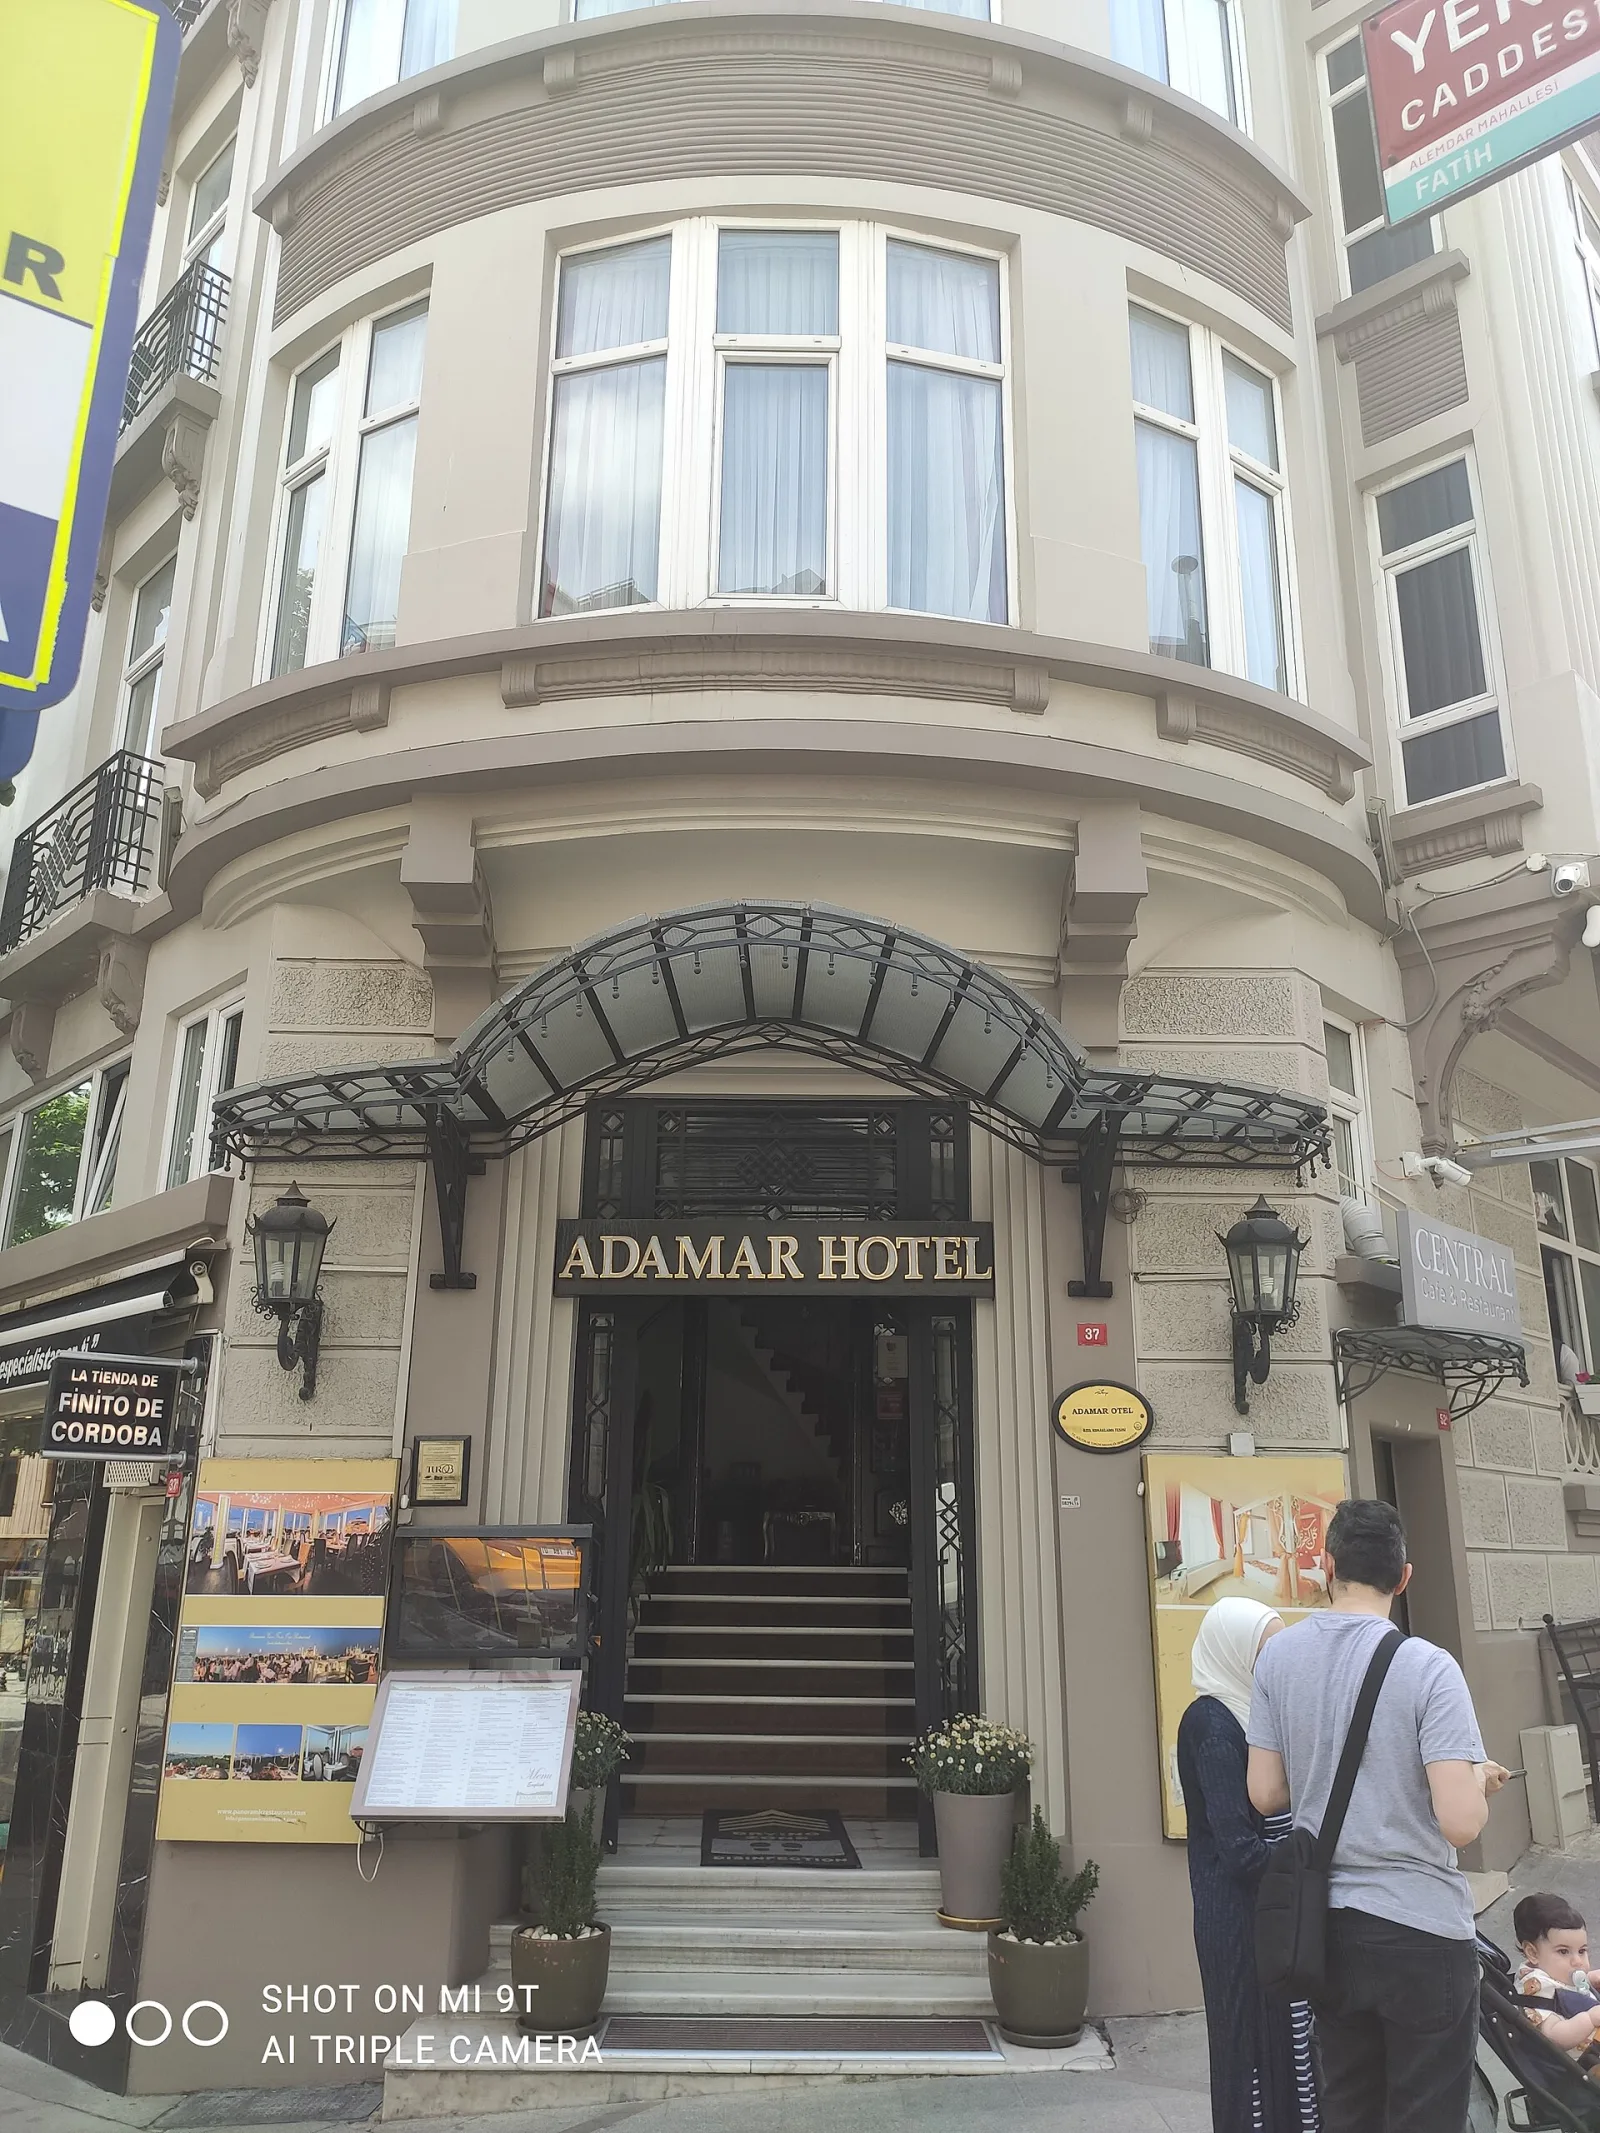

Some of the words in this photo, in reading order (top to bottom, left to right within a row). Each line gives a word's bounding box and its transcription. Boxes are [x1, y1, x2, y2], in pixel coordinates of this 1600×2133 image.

[1401, 0, 1600, 131] CADDES
[1409, 127, 1474, 172] ALEMDAR
[1477, 80, 1559, 133] MAHALLESİ
[1415, 142, 1493, 200] FATİH
[558, 1235, 805, 1280] ADAMAR
[818, 1235, 993, 1280] HOTEL
[1415, 1228, 1513, 1298] CENTRAL
[1421, 1277, 1447, 1303] Cafe
[1449, 1285, 1458, 1306] &
[1460, 1289, 1516, 1324] Restaurant
[1084, 1327, 1100, 1341] 37
[71, 1368, 88, 1383] LA
[141, 1374, 159, 1387] DE
[58, 1387, 130, 1417] FİNİTO
[135, 1397, 165, 1418] DE
[1072, 1407, 1109, 1415] ADAMAR
[51, 1421, 162, 1447] CORDOBA
[713, 1855, 848, 1863] DISINFECTION
